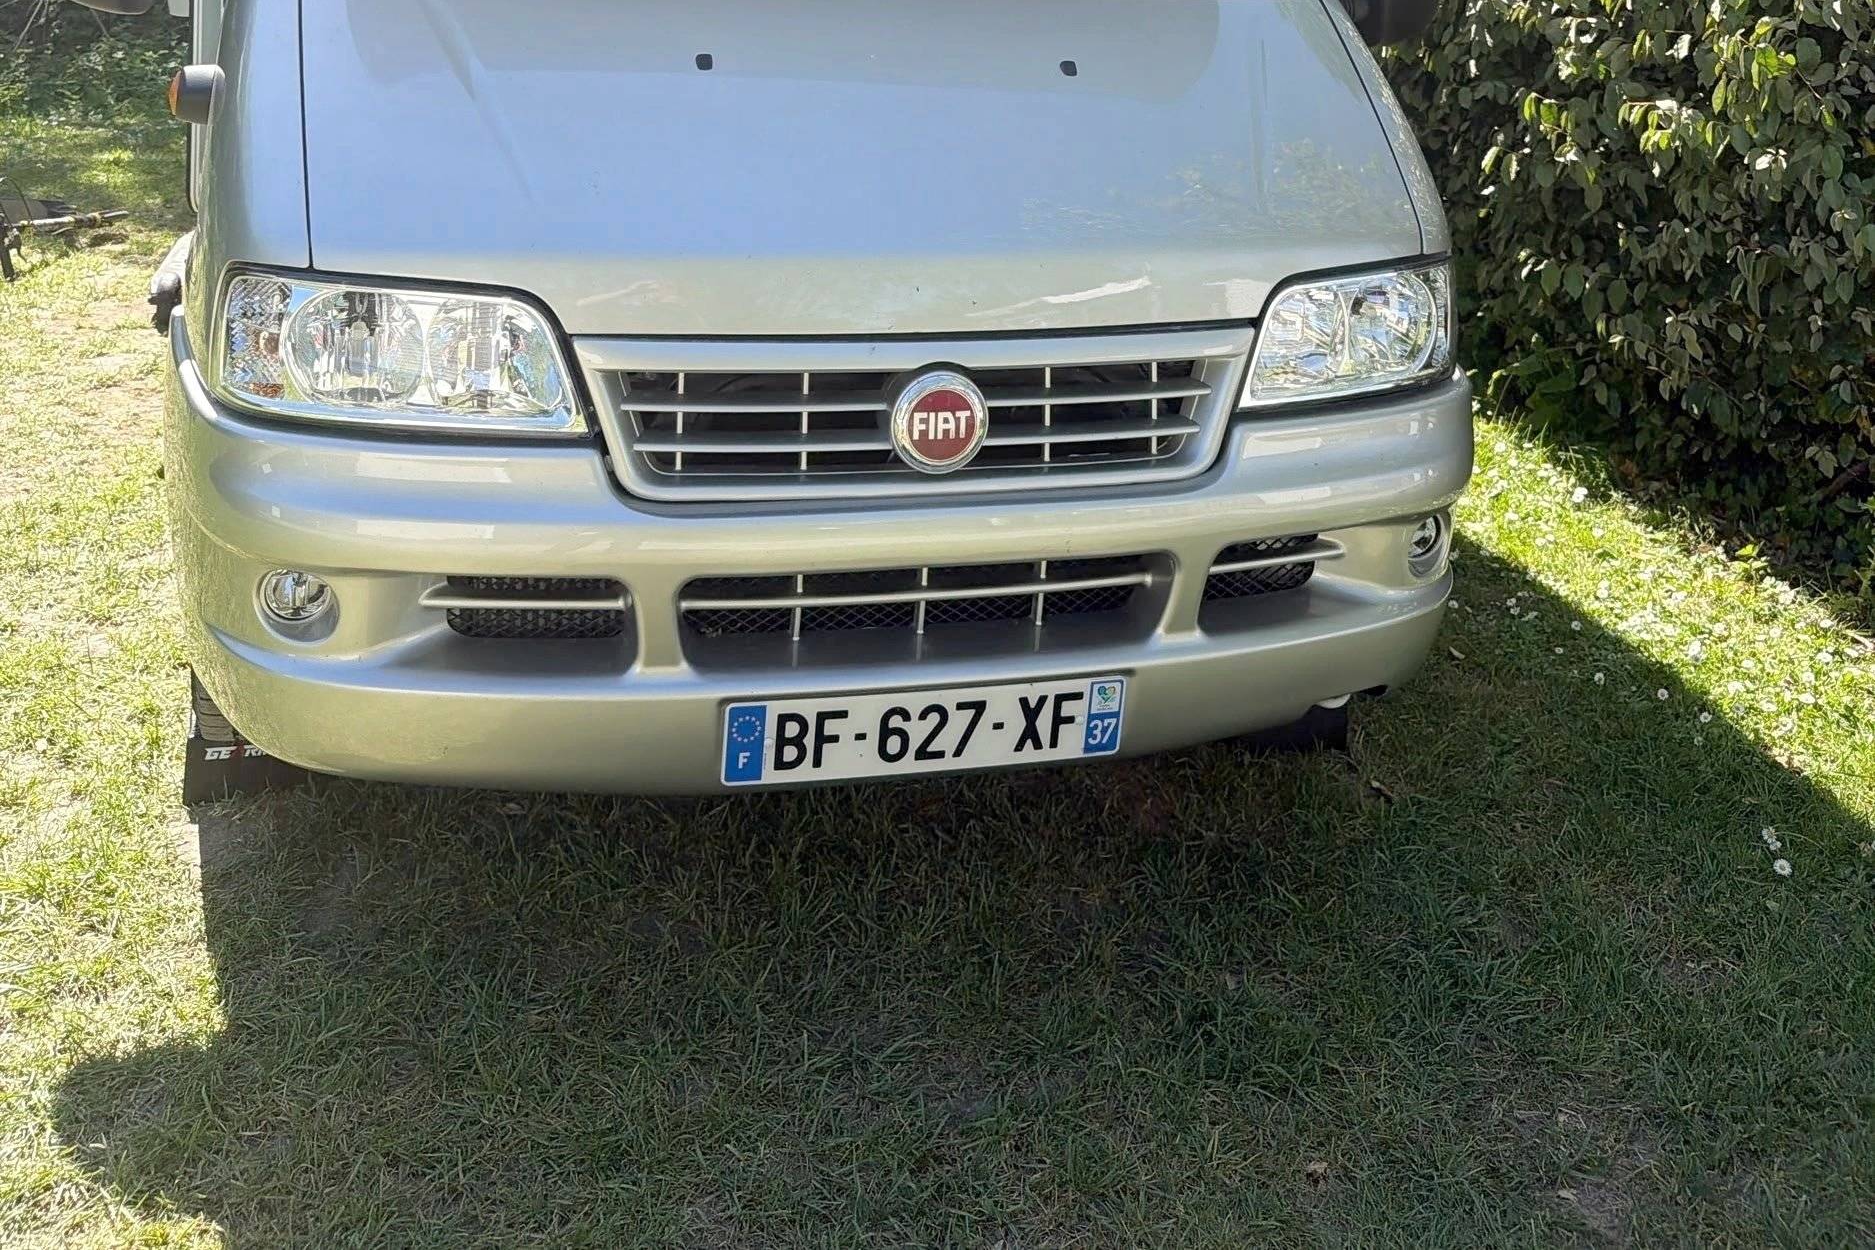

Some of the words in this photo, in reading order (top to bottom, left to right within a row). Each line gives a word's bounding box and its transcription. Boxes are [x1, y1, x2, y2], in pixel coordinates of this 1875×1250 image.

[912, 410, 971, 441] FIAT
[773, 691, 1084, 771] BF-627-XF
[1088, 717, 1117, 745] 37
[738, 752, 751, 769] F
